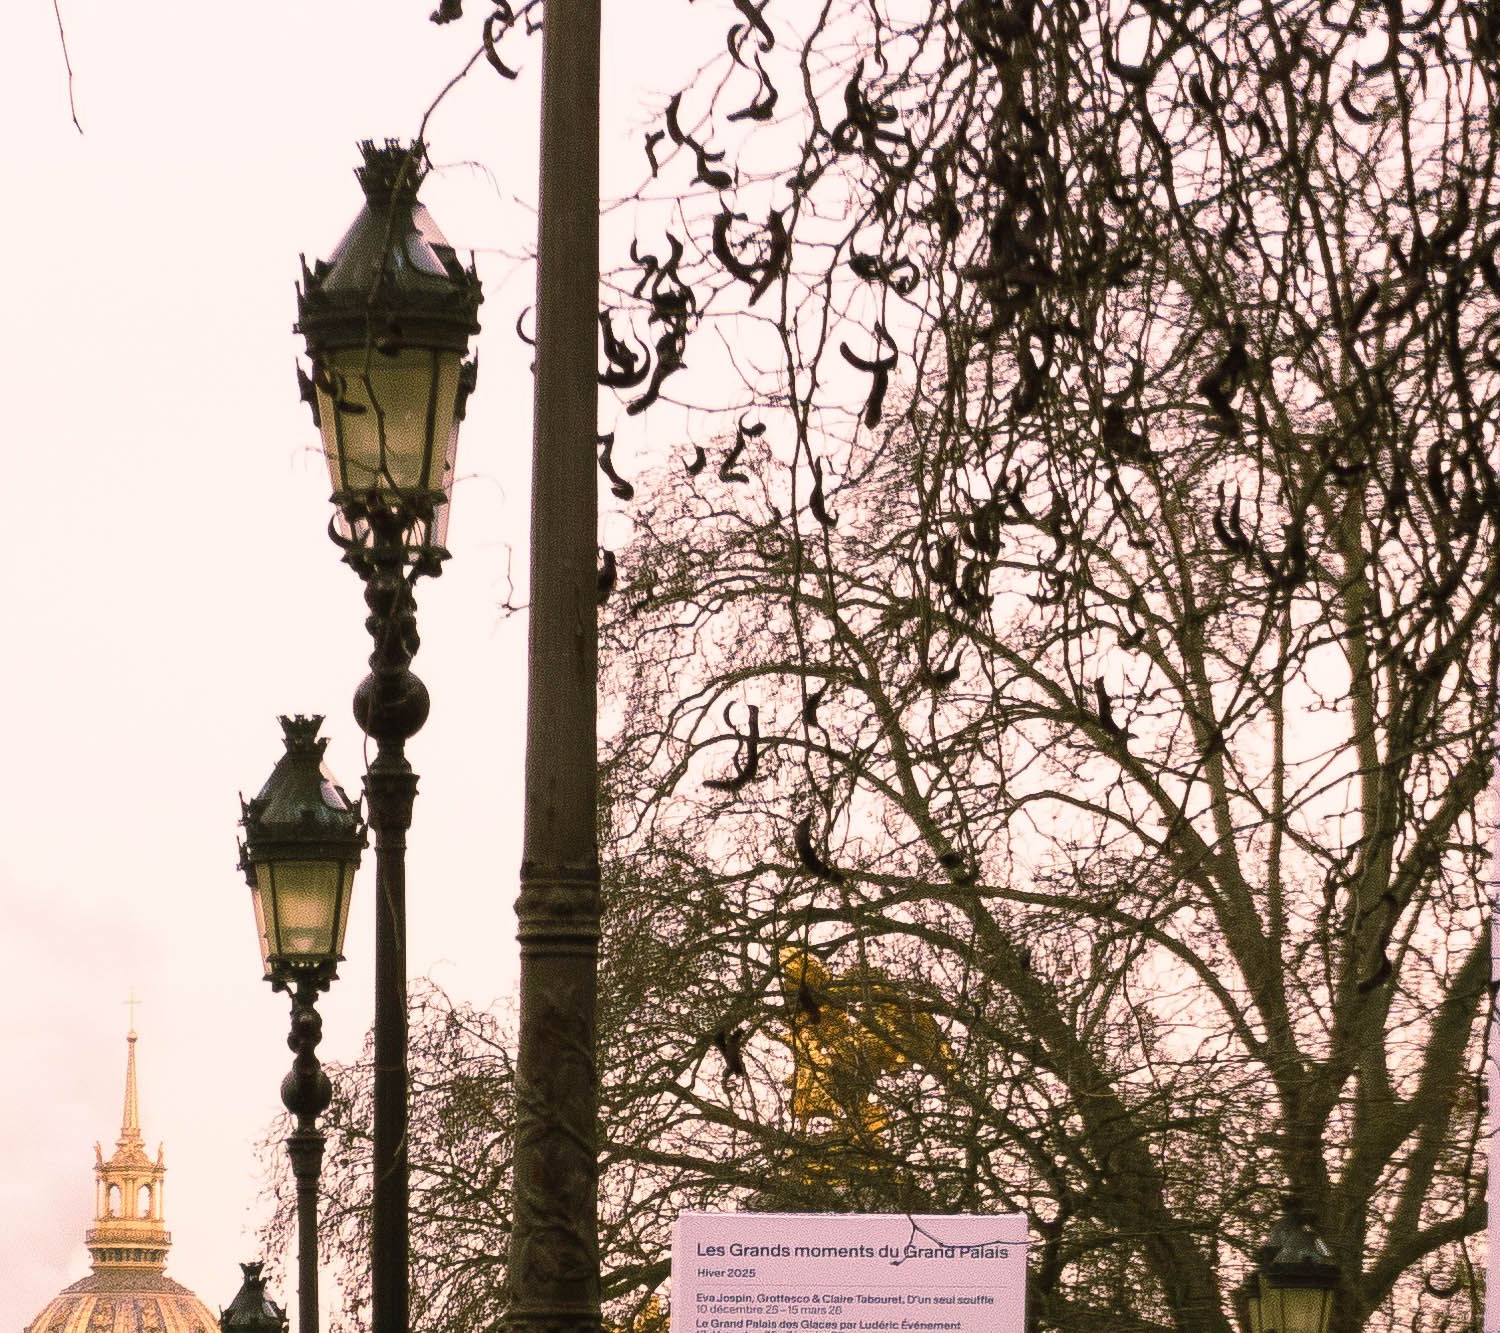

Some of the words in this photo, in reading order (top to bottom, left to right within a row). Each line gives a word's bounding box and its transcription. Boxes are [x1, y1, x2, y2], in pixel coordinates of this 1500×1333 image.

[697, 1244, 725, 1257] Les
[729, 1244, 791, 1257] Grands
[794, 1245, 874, 1257] moments
[878, 1245, 900, 1258] du
[904, 1245, 955, 1258] Grand
[959, 1245, 1009, 1258] Palais
[698, 1268, 726, 1278] Hiver
[727, 1268, 756, 1278] 2025
[696, 1294, 715, 1304] Eva
[811, 1295, 820, 1305] &
[822, 1295, 853, 1305] Claire
[933, 1295, 955, 1305] seul
[957, 1296, 994, 1306] souffle
[696, 1305, 708, 1315] 10
[709, 1305, 763, 1315] décembre
[696, 1319, 709, 1329] Le
[710, 1319, 744, 1329] Grand
[745, 1319, 777, 1329] Palais
[779, 1319, 798, 1329] des
[800, 1319, 837, 1329] Glaces
[840, 1322, 857, 1332] par
[859, 1320, 899, 1330] Ludéric
[901, 1318, 961, 1330] Événement
